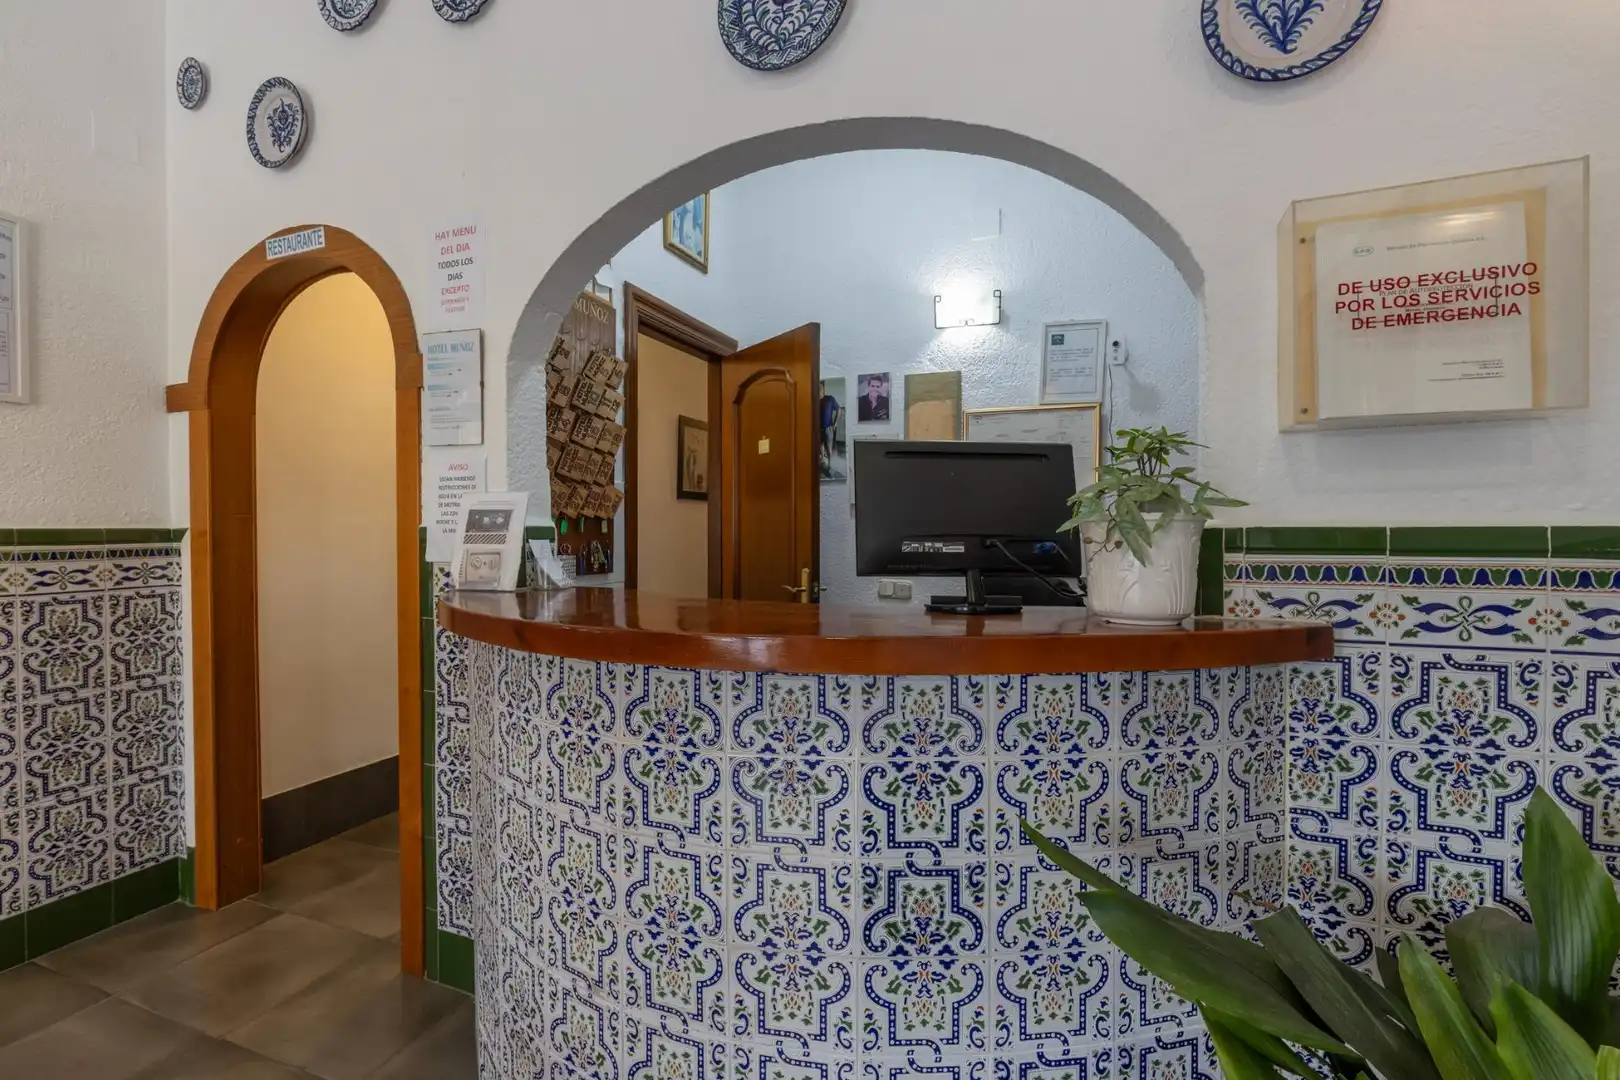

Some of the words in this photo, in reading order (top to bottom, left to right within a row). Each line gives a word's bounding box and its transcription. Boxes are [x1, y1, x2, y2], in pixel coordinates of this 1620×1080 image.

[434, 230, 451, 241] HAY
[452, 225, 477, 237] MENU
[267, 228, 323, 257] RESTAURANTE
[440, 245, 454, 256] DEL
[456, 242, 470, 253] DIA
[438, 259, 460, 270] TODOS
[461, 257, 474, 267] LOS
[447, 272, 463, 282] DIAS
[1337, 281, 1363, 296] DE
[1369, 276, 1411, 293] USO
[1417, 262, 1538, 288] EXCLUSIVO
[1335, 298, 1376, 314] POR
[1381, 293, 1421, 310] LOS
[1427, 281, 1541, 306] SERVICIOS
[1351, 316, 1377, 331] DE
[1383, 302, 1522, 328] EMERGENCIA
[447, 463, 469, 472] AVISO
